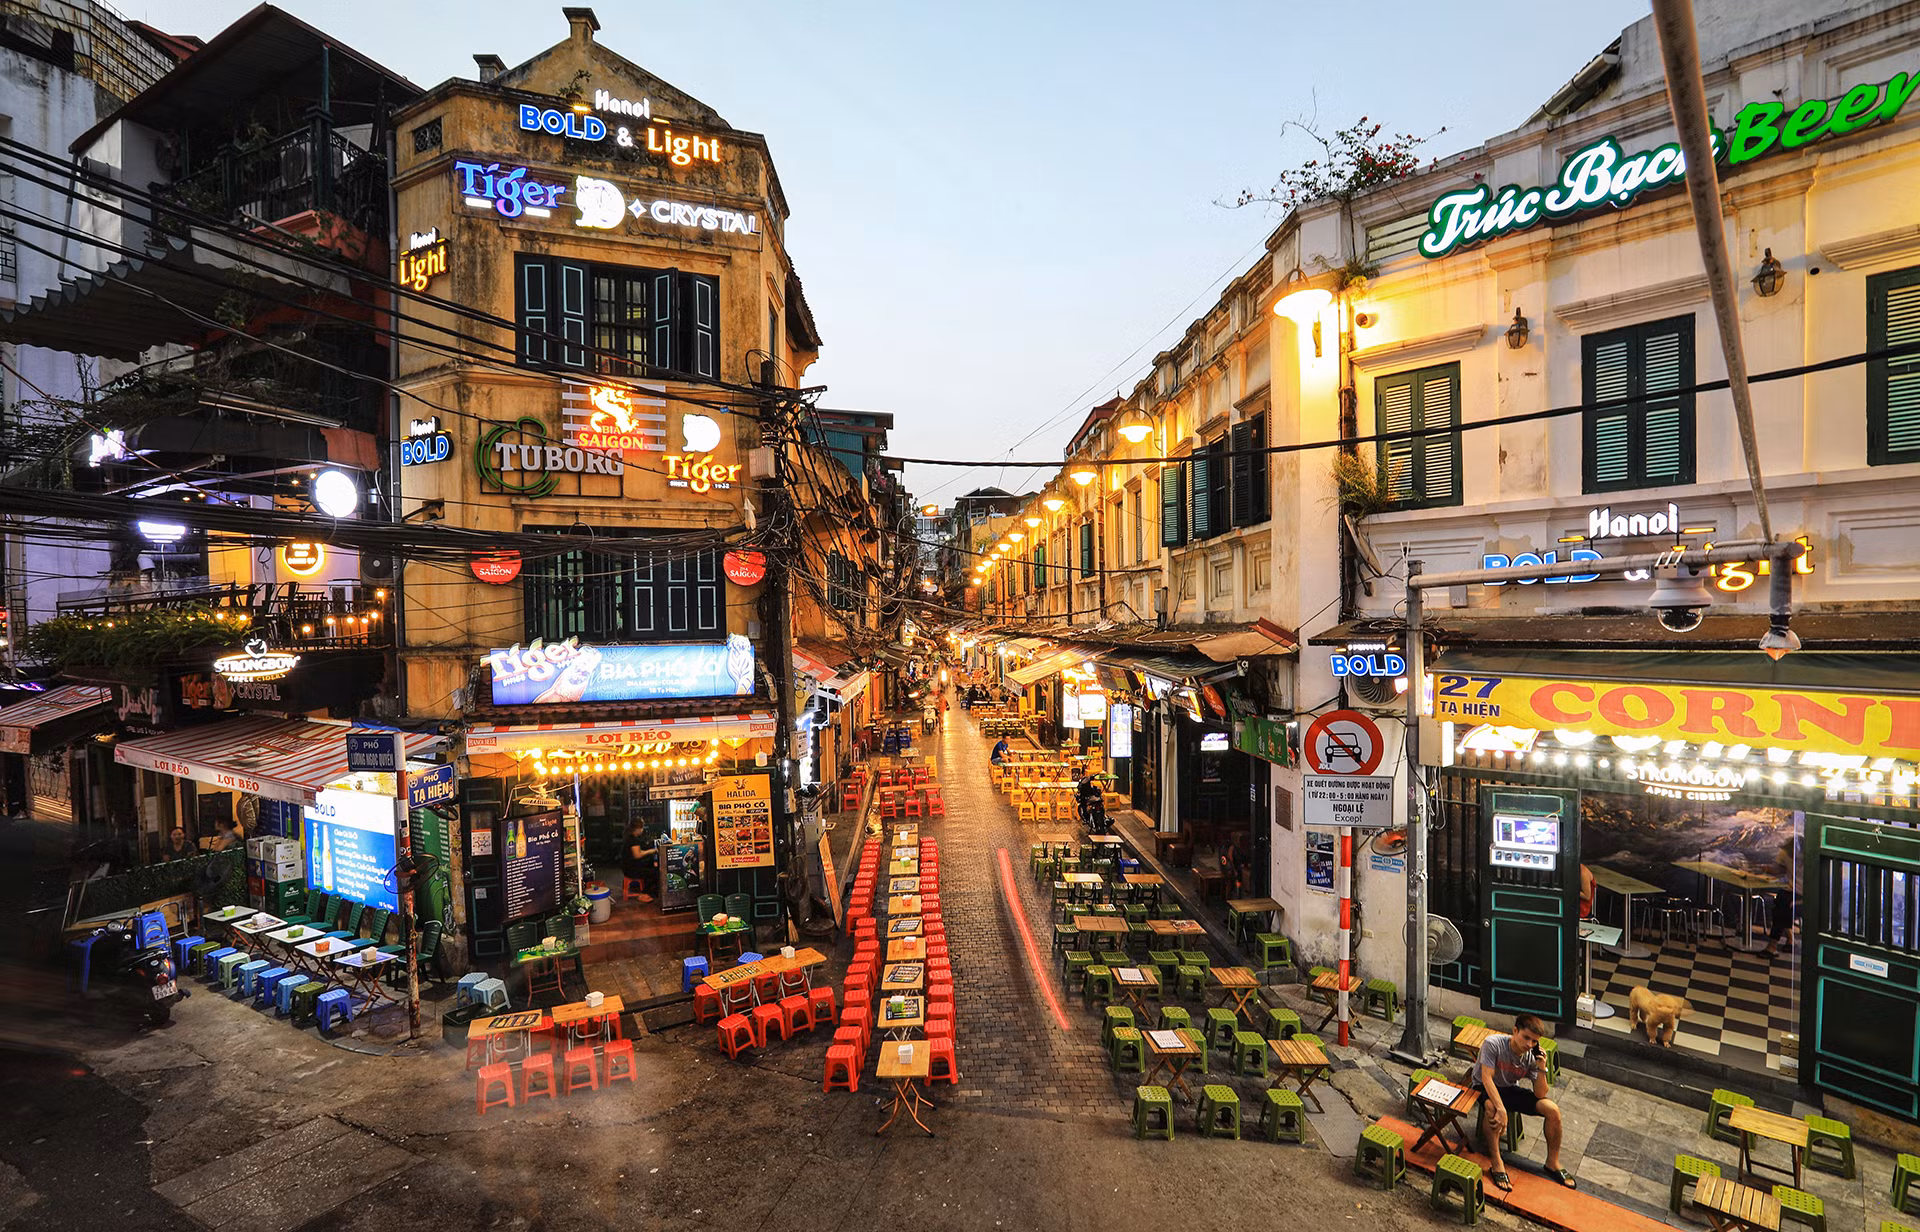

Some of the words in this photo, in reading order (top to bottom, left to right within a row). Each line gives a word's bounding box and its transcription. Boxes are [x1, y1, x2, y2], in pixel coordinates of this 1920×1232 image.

[595, 89, 650, 120] Hanoi
[519, 103, 607, 142] BOLD
[616, 127, 634, 148] &
[647, 127, 721, 166] Light
[455, 161, 566, 218] Tiger
[1423, 189, 1541, 254] Trúc
[1545, 134, 1720, 213] Bạc
[651, 200, 761, 235] CRYSTAL
[400, 245, 446, 291] Light
[602, 425, 621, 434] BIA
[401, 435, 449, 466] BOLD
[579, 433, 644, 451] SAIGON
[495, 441, 625, 477] TUBORG
[661, 453, 742, 493] Tiger
[1589, 502, 1680, 540] Hanoi
[480, 568, 512, 576] SAIGON
[730, 570, 758, 578] SAIGON
[213, 657, 298, 673] STRONGBOW
[480, 635, 581, 682] Tiger
[1330, 654, 1405, 677] BOLD
[600, 663, 637, 681] BIA
[237, 683, 281, 700] CRYSTAL
[1439, 676, 1503, 698] 27
[1440, 701, 1458, 716] TẠ
[1463, 701, 1500, 718] HIỆN
[363, 739, 379, 749] PHỐ
[629, 729, 672, 743] BÉO
[171, 762, 190, 776] BÉO
[423, 770, 439, 784] PHỐ
[1627, 765, 1746, 789] STRONGBOW
[217, 773, 234, 788] LỢI
[239, 777, 260, 792] BÉO
[1315, 778, 1327, 788] QUÉT
[1361, 782, 1375, 790] HOẠT
[413, 788, 426, 804] TẠ
[427, 780, 449, 799] HIỆN
[727, 790, 756, 798] HALIDA
[1646, 786, 1682, 800] APPLE
[1687, 789, 1731, 801] CIDERS
[315, 802, 336, 817] BOLD
[1333, 803, 1354, 814] NGOẠI
[1356, 803, 1364, 814] LỆ
[1335, 814, 1362, 824] Except
